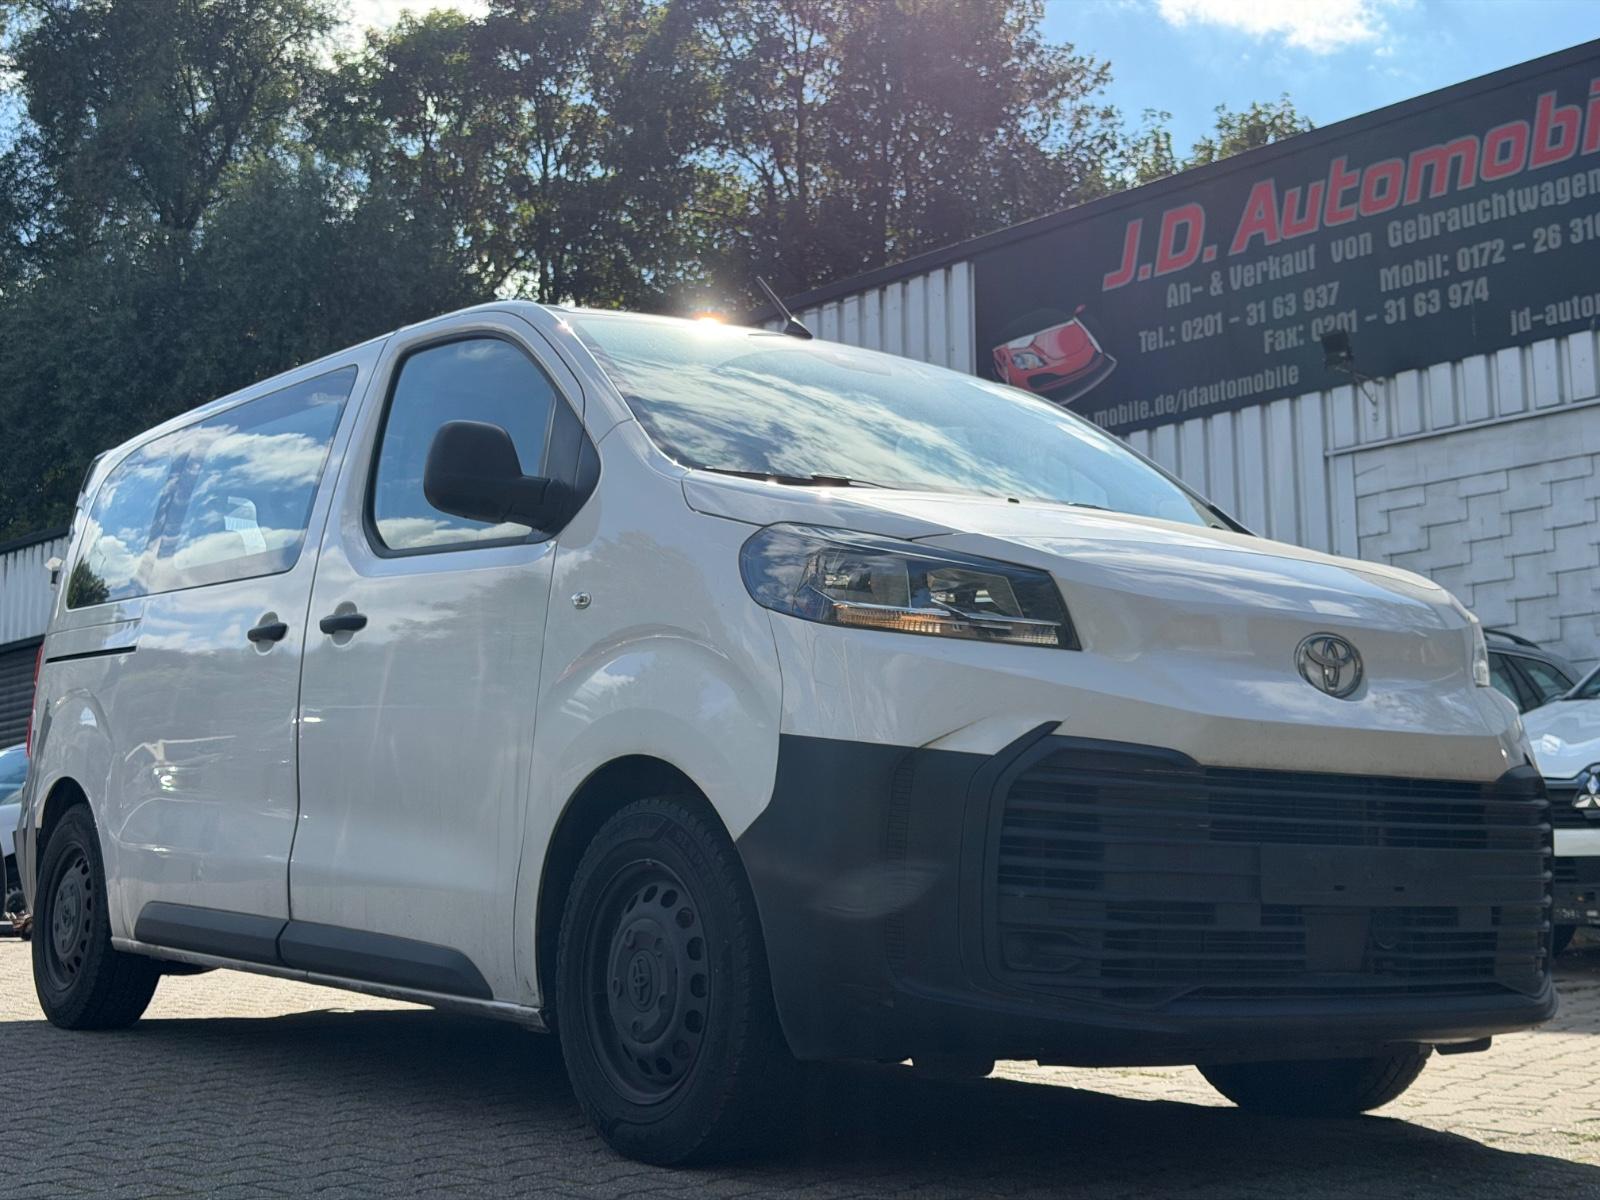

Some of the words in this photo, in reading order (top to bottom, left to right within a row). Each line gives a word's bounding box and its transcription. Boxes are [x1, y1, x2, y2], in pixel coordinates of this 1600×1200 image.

[1102, 203, 1218, 291] J.D.
[1166, 282, 1203, 308] An-
[1209, 270, 1224, 297] &
[1229, 244, 1316, 291] Verkauf
[1330, 232, 1373, 263] von
[1387, 168, 1600, 248] Gebrauchtwagen
[1379, 253, 1450, 292] Mobil:
[1456, 238, 1506, 273] 0172
[1532, 224, 1562, 254] 26
[1138, 326, 1176, 353] Tel.:
[1181, 312, 1223, 342] 0201
[1246, 300, 1266, 326] 31
[1272, 292, 1297, 320] 63
[1303, 281, 1340, 312] 937
[1263, 324, 1305, 354] Fax:
[1311, 309, 1357, 342] 0201
[1384, 297, 1407, 325] 31
[1413, 289, 1441, 318] 63
[1447, 276, 1489, 309] 974
[1085, 364, 1300, 428] mobile.de/jdautomobile
